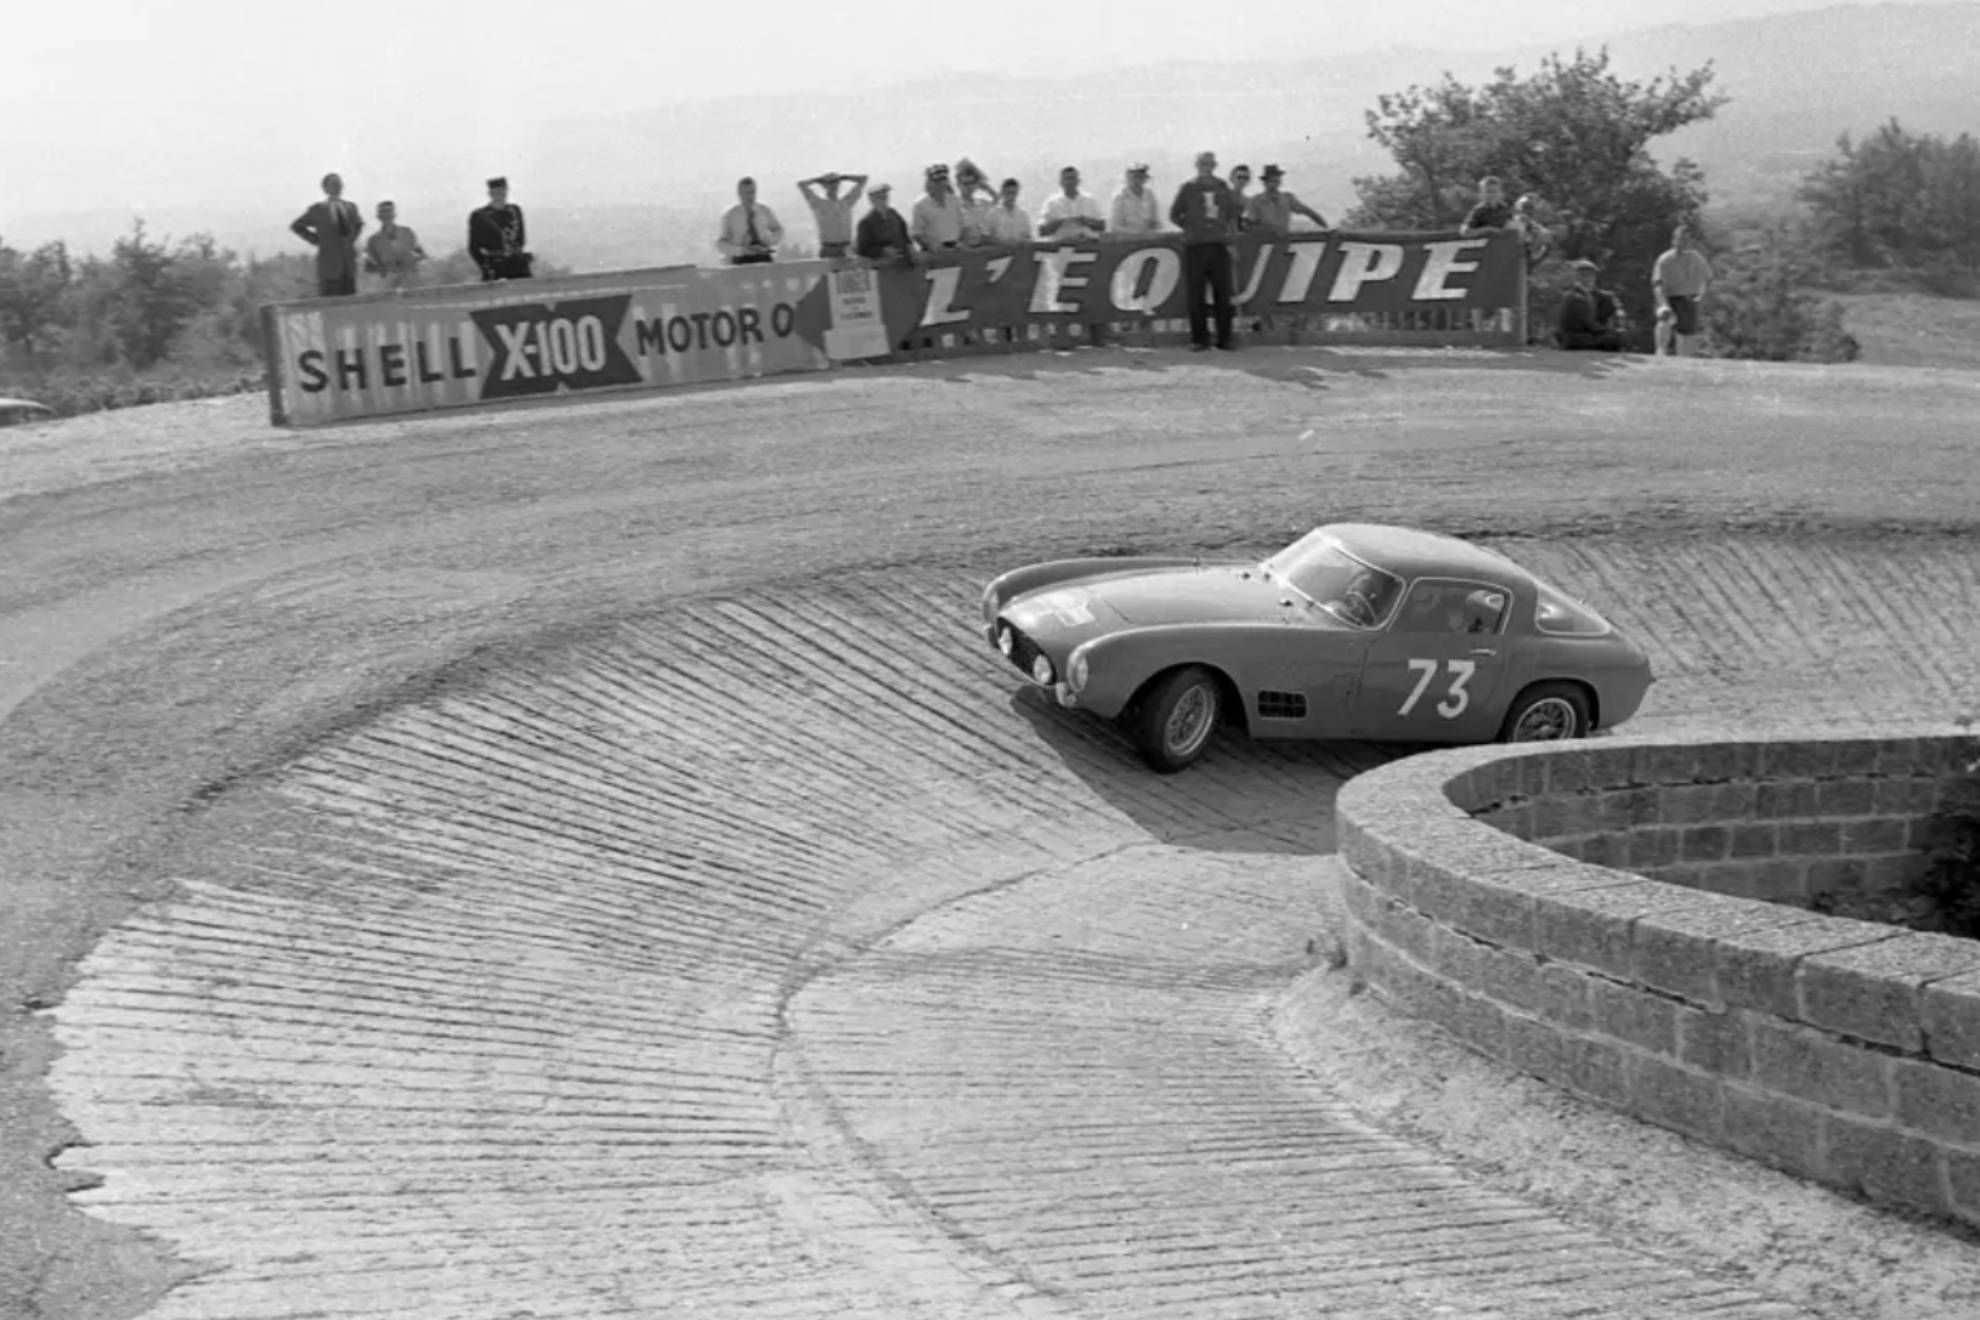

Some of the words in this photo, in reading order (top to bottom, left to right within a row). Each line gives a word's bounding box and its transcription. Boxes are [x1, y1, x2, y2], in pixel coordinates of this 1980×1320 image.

[299, 336, 477, 392] SHELL
[494, 314, 606, 381] X-100
[634, 306, 765, 356] MOTOR
[1397, 658, 1475, 718] 73
